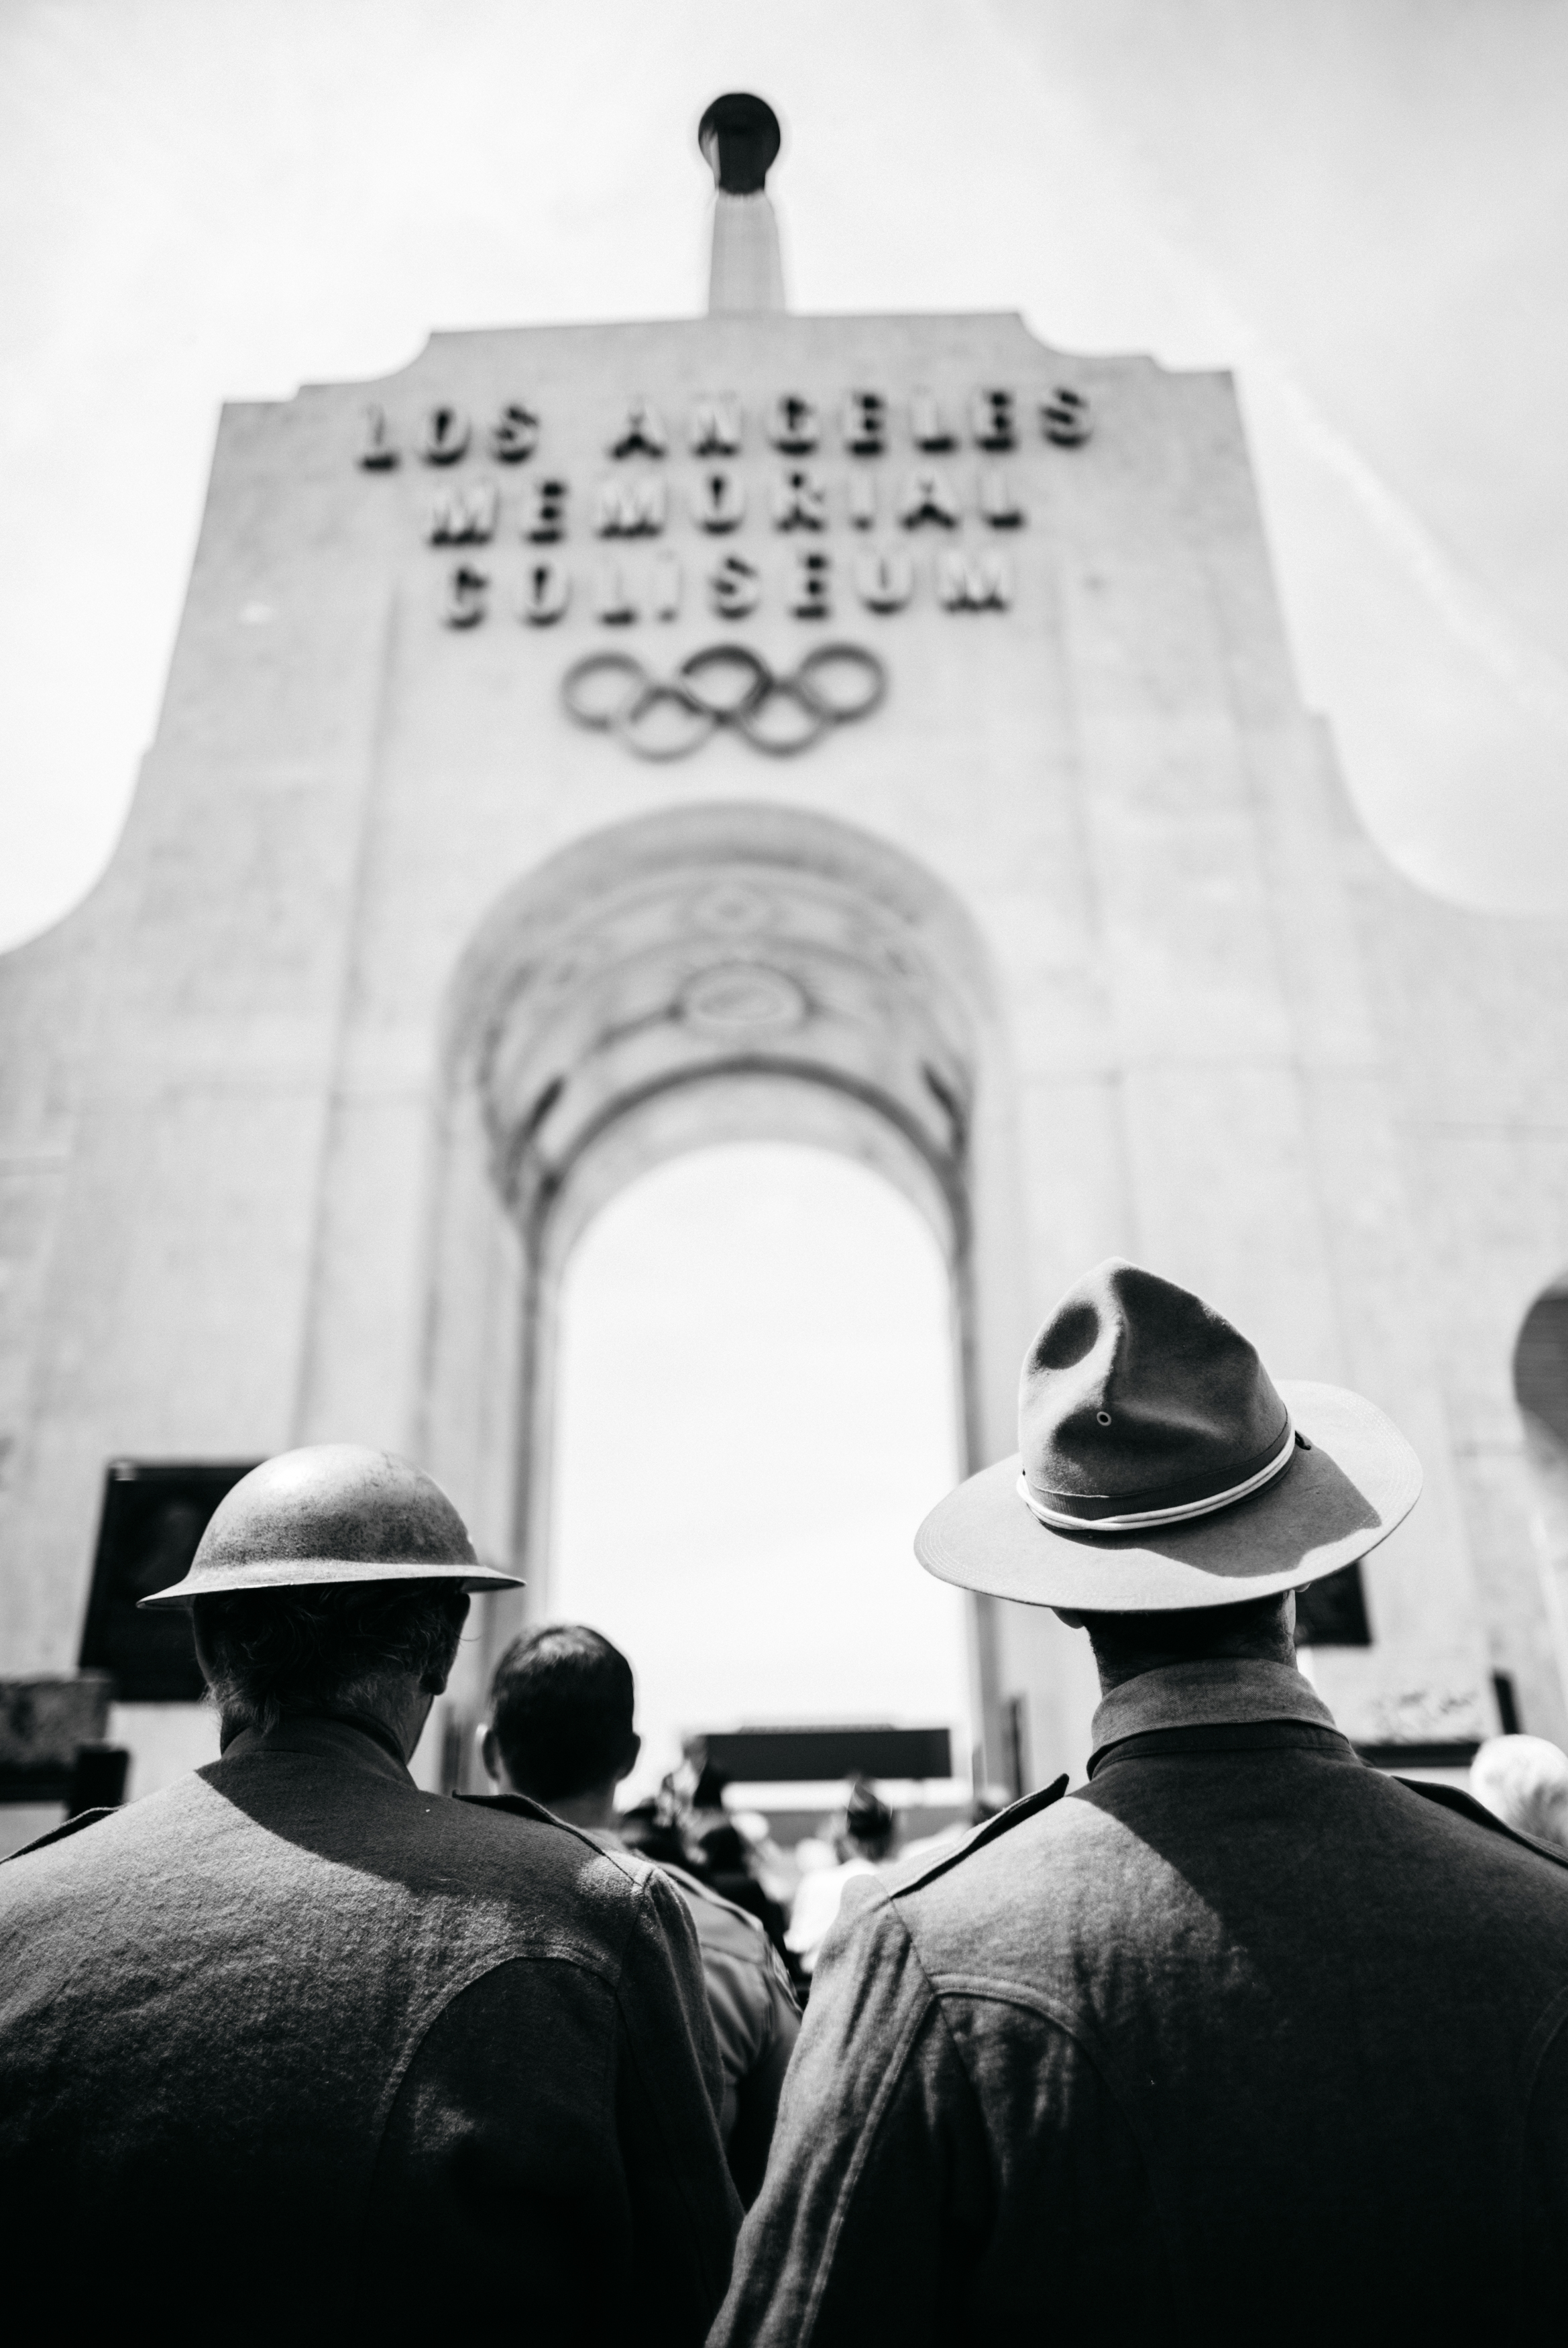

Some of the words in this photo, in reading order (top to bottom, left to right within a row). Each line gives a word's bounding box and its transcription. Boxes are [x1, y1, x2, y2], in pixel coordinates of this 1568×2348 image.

[357, 398, 542, 474] LOS
[605, 384, 1097, 463] ANGELES
[425, 467, 1029, 549] MEMORIAL
[443, 550, 1014, 632] COLISEUM
